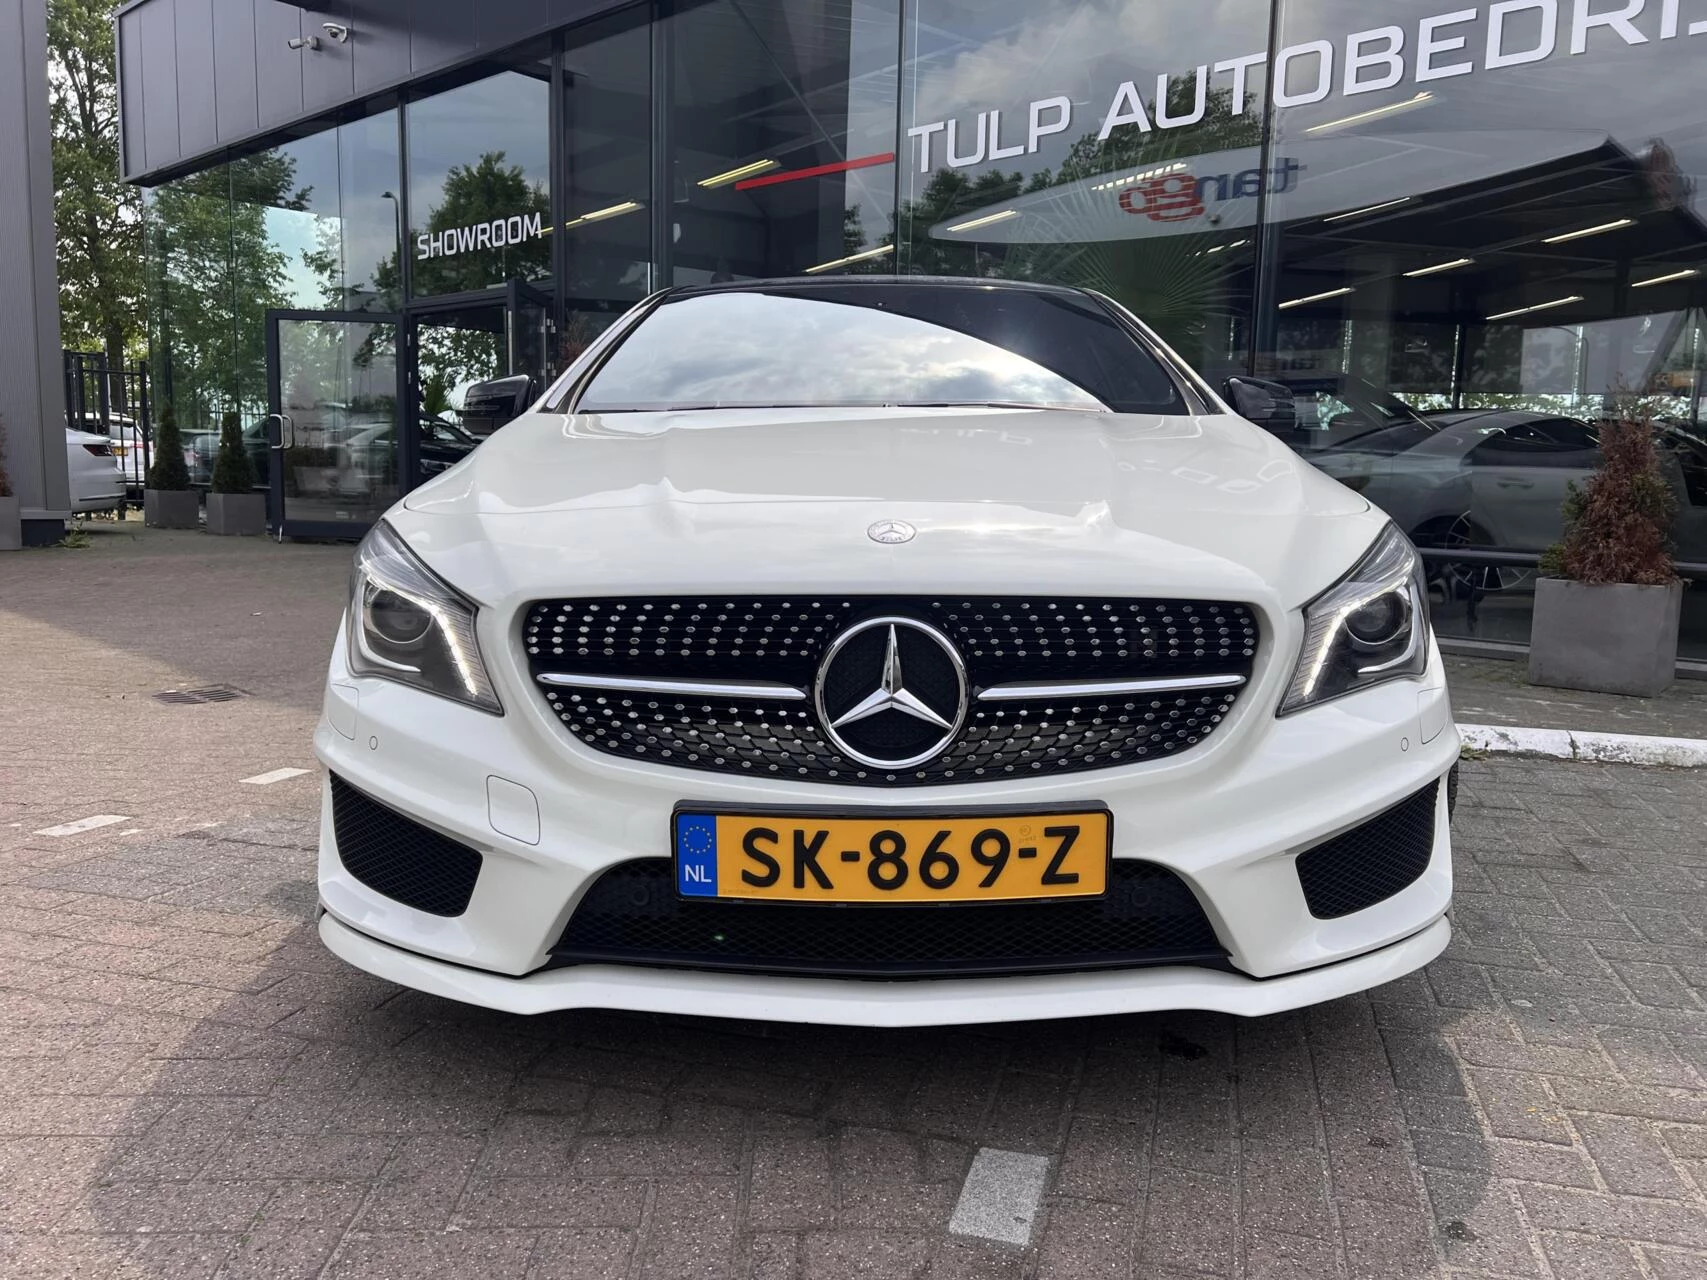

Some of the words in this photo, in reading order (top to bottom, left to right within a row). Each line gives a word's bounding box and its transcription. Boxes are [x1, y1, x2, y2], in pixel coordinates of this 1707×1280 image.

[908, 95, 1073, 174] TULP
[1097, 0, 1707, 140] AUTOBEDRI
[417, 212, 542, 260] SHOWROOM
[684, 864, 712, 883] NL
[741, 826, 1080, 890] SK-869-Z
